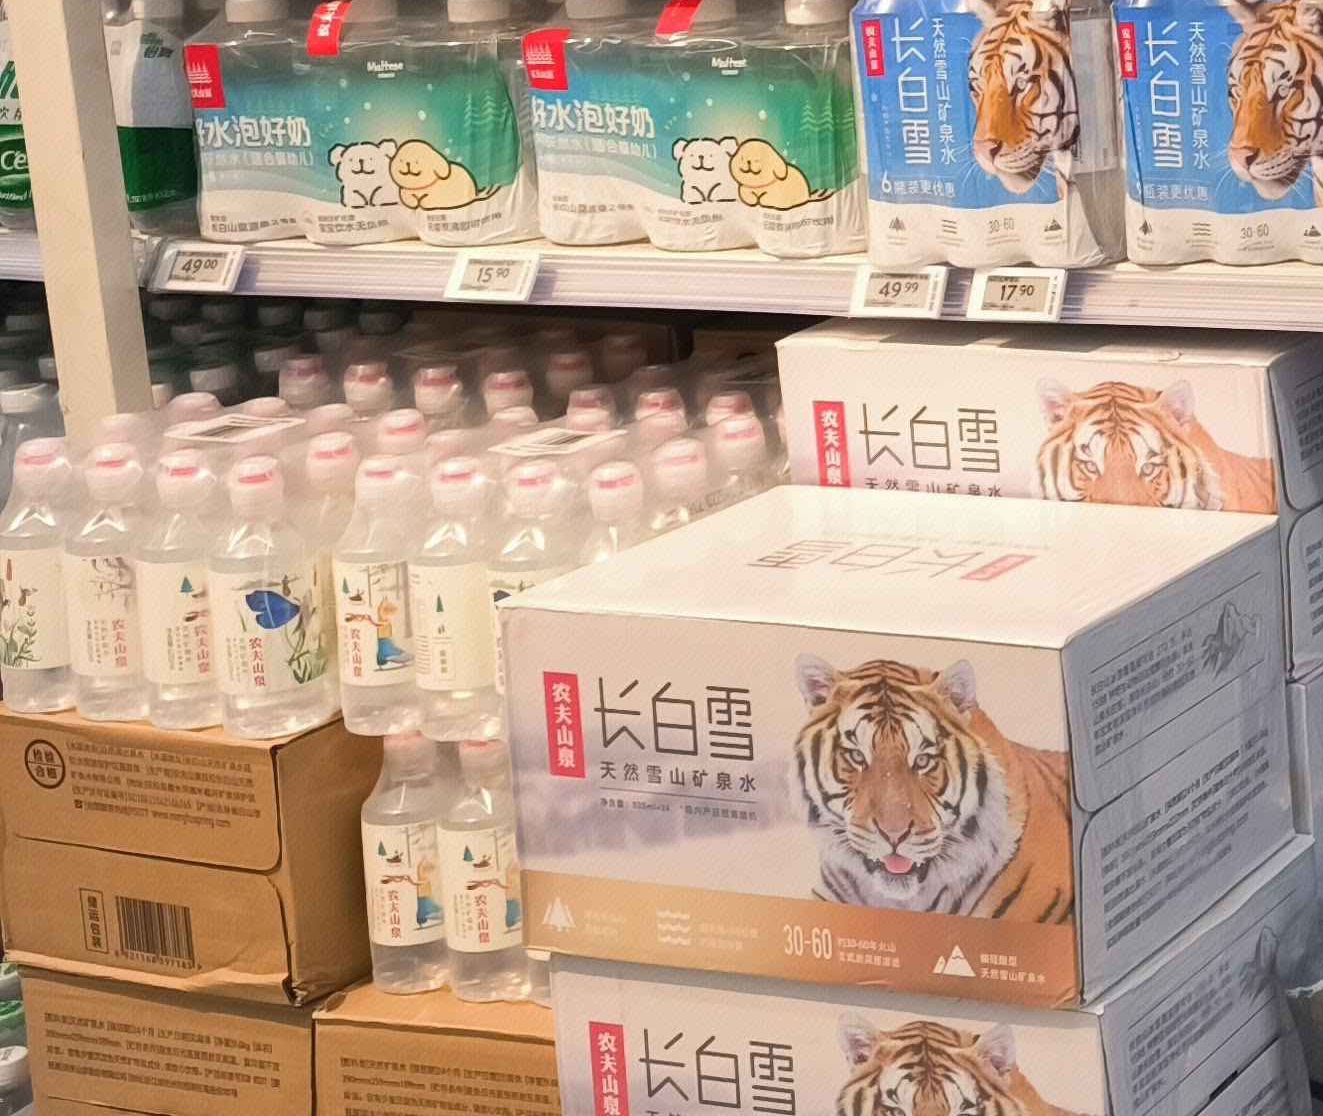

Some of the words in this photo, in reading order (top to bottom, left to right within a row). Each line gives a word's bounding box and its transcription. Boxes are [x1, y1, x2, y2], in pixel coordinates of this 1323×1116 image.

[892, 16, 932, 165] 长白雪
[932, 18, 956, 165] 天然雪山矿泉水
[881, 170, 956, 198] 6瓶装更优惠
[820, 408, 843, 486] 农夫山泉
[858, 401, 1000, 474] 长白雪
[551, 681, 577, 770] 农夫山泉
[594, 678, 755, 762] 长白雪
[599, 761, 757, 795] 天然雪山矿泉水
[782, 924, 833, 960] 30-60
[596, 1031, 622, 1116] 农夫山泉
